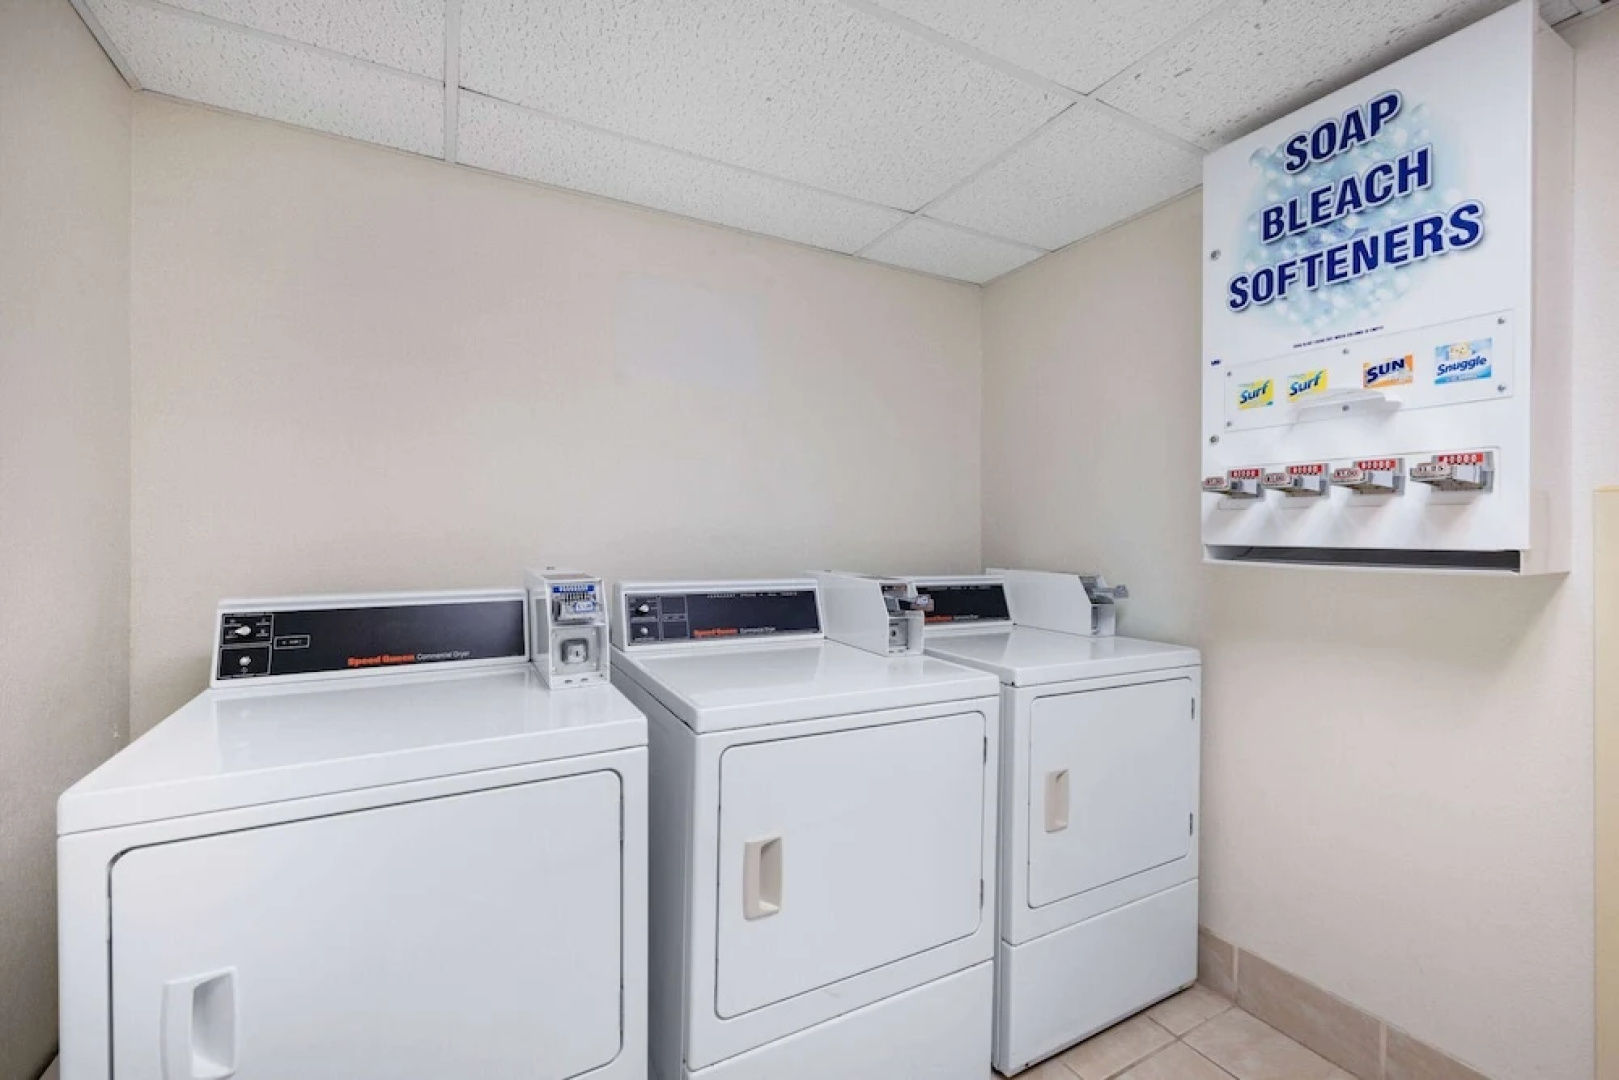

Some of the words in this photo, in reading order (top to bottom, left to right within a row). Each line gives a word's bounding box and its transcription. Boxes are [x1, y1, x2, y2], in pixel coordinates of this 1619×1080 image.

[1285, 90, 1400, 173] SOAP
[1261, 146, 1431, 242] BLEACH
[1229, 201, 1482, 309] SOFTENERS
[1367, 358, 1405, 384] SUN
[1437, 355, 1487, 376] Snuggle
[1239, 379, 1270, 404] Surf
[1289, 370, 1324, 396] Surf
[348, 656, 381, 667] Speed
[382, 654, 415, 663] Queen
[417, 652, 452, 661] Commercial
[453, 650, 470, 658] Dryer
